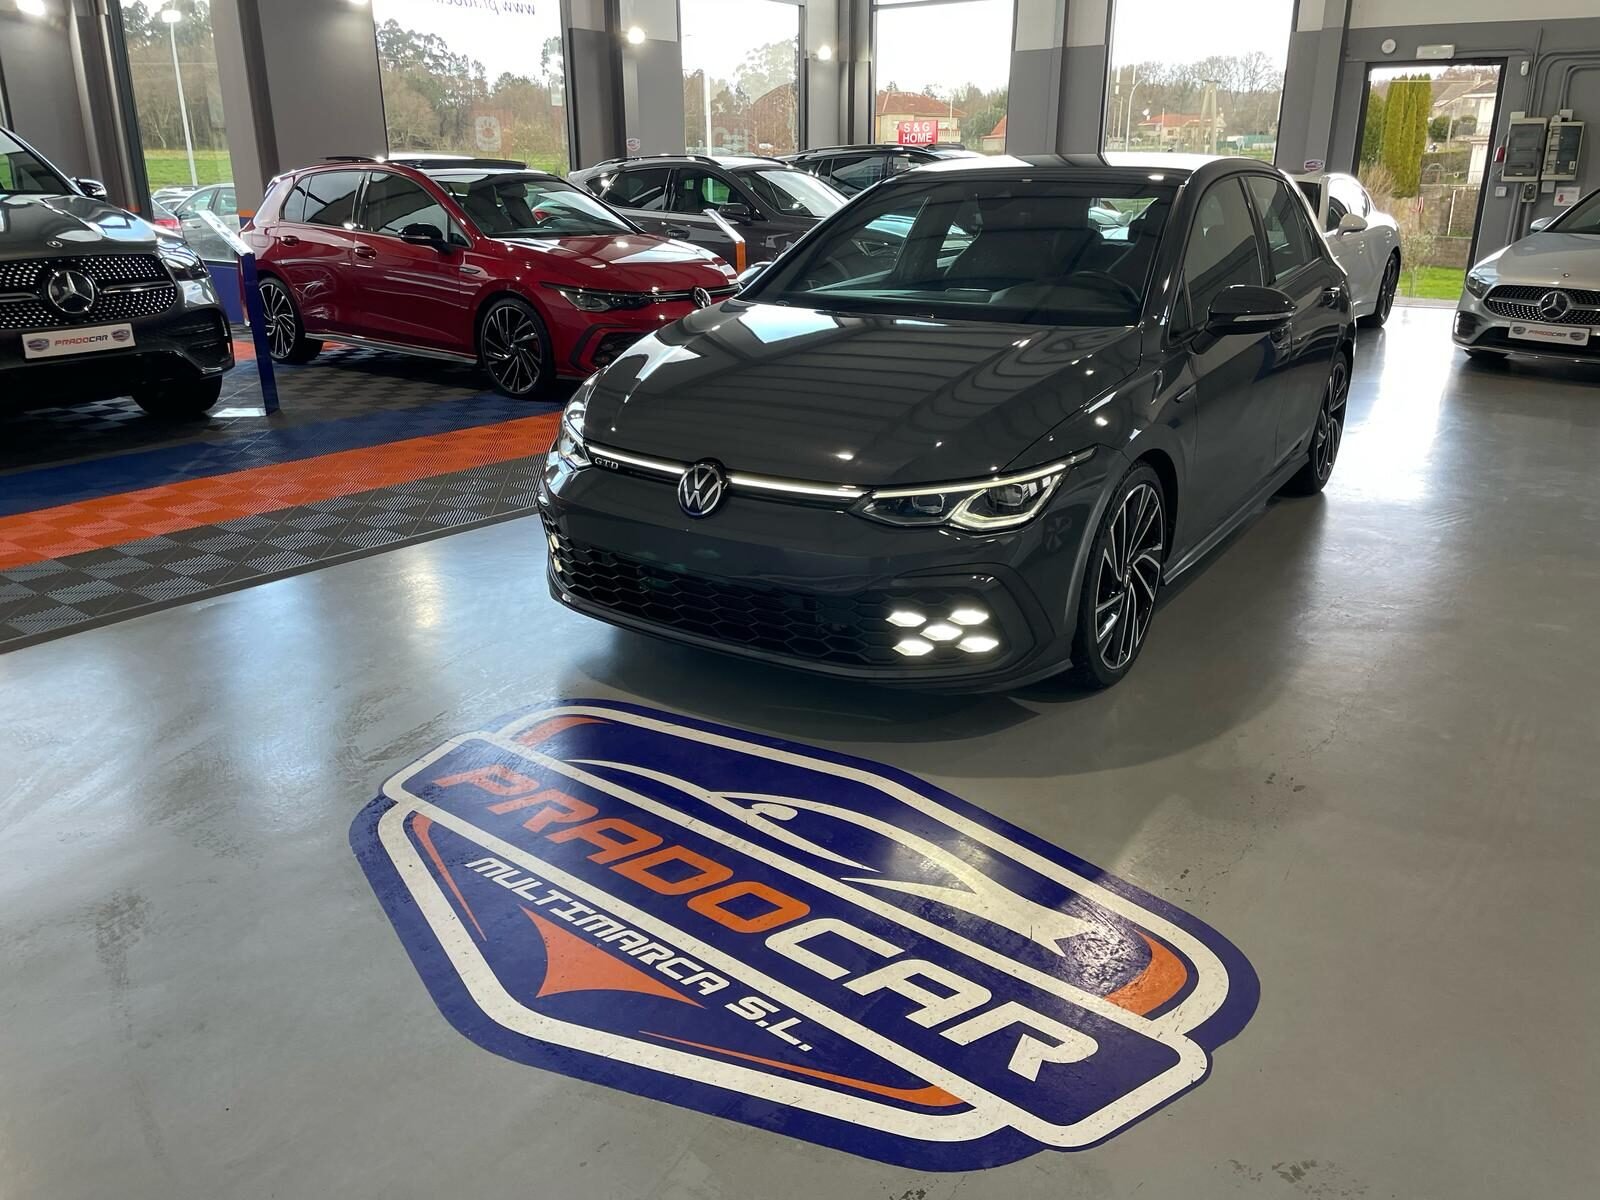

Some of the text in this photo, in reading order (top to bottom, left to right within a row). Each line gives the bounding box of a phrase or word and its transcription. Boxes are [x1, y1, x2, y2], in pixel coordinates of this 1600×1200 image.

[904, 121, 930, 132] S & G
[902, 132, 932, 143] HOME
[54, 335, 108, 346] PRADOCAR
[594, 457, 619, 470] GTD
[431, 763, 1099, 1082] PRADOCAR
[464, 856, 813, 1052] MULTIMARCA S.L.
